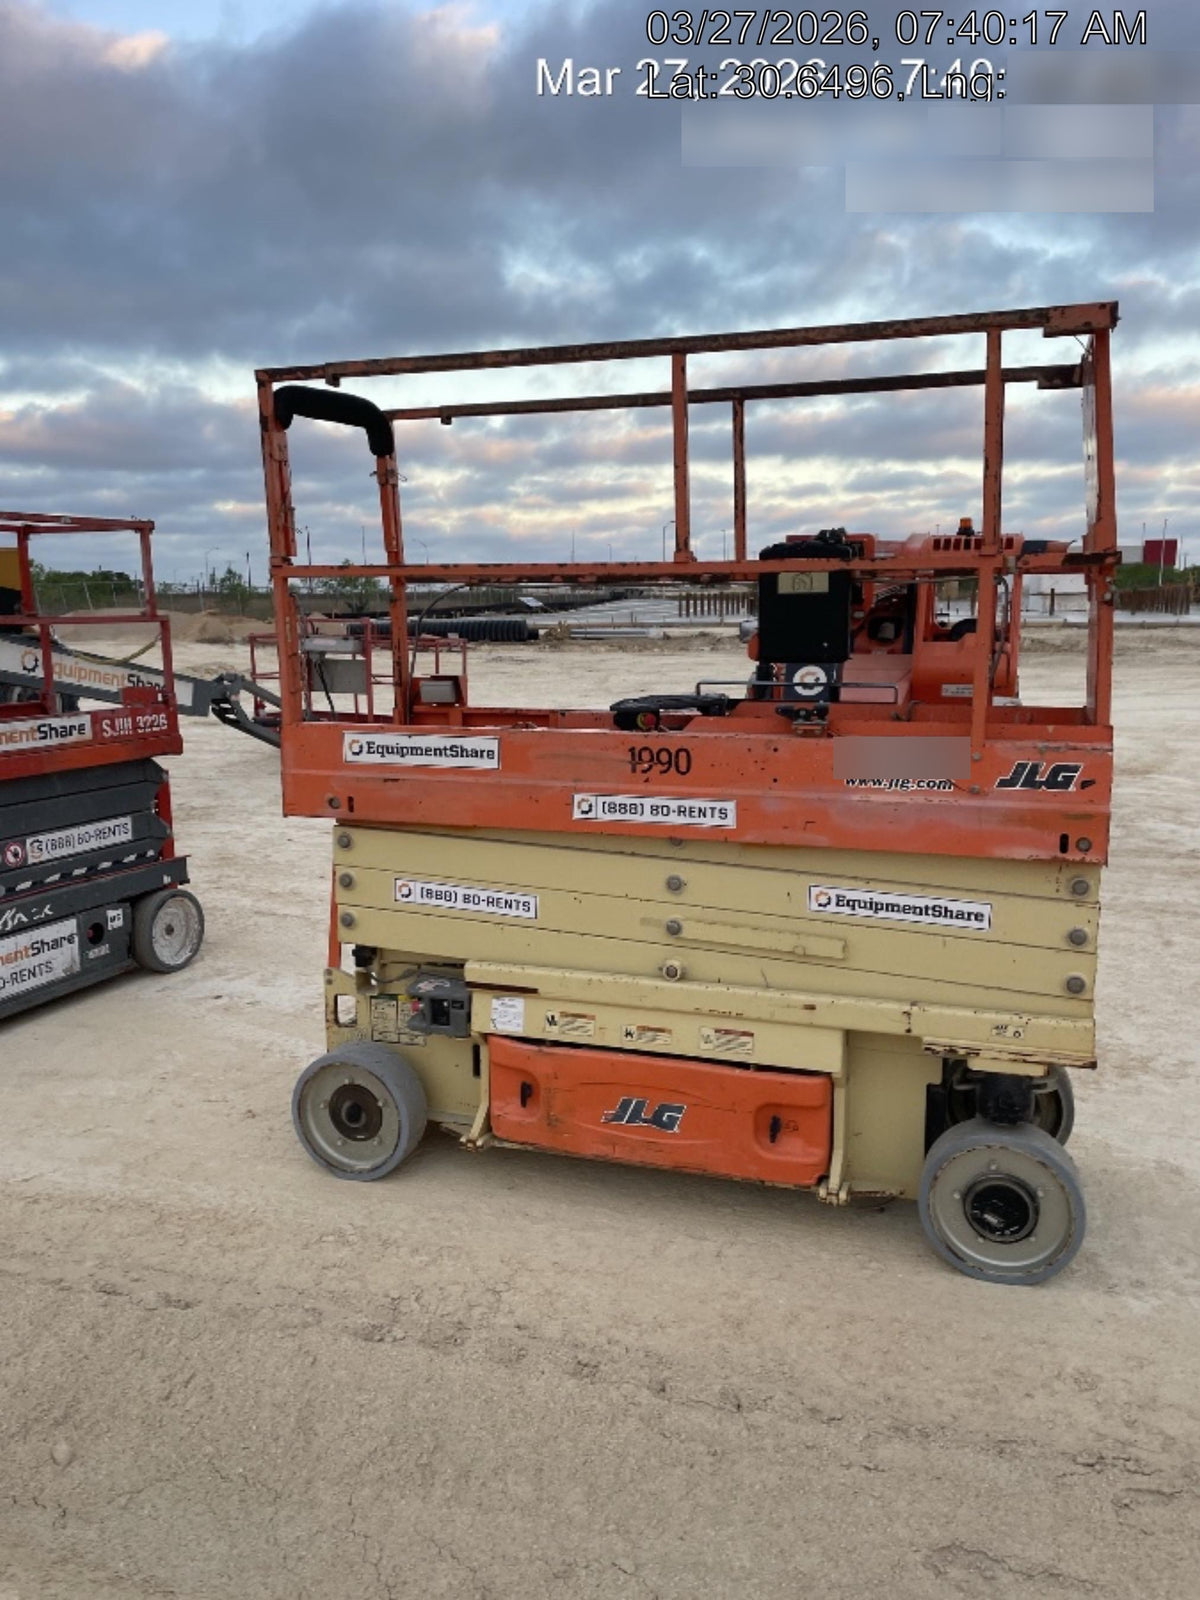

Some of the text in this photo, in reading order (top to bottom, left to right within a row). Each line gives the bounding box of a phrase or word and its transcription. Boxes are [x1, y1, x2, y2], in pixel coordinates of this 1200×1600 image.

[366, 741, 495, 760] EquipmentShare
[628, 746, 692, 775] 1990
[995, 761, 1083, 791] JLG
[835, 894, 984, 923] EquipmentShare
[600, 1096, 687, 1133] JLG
